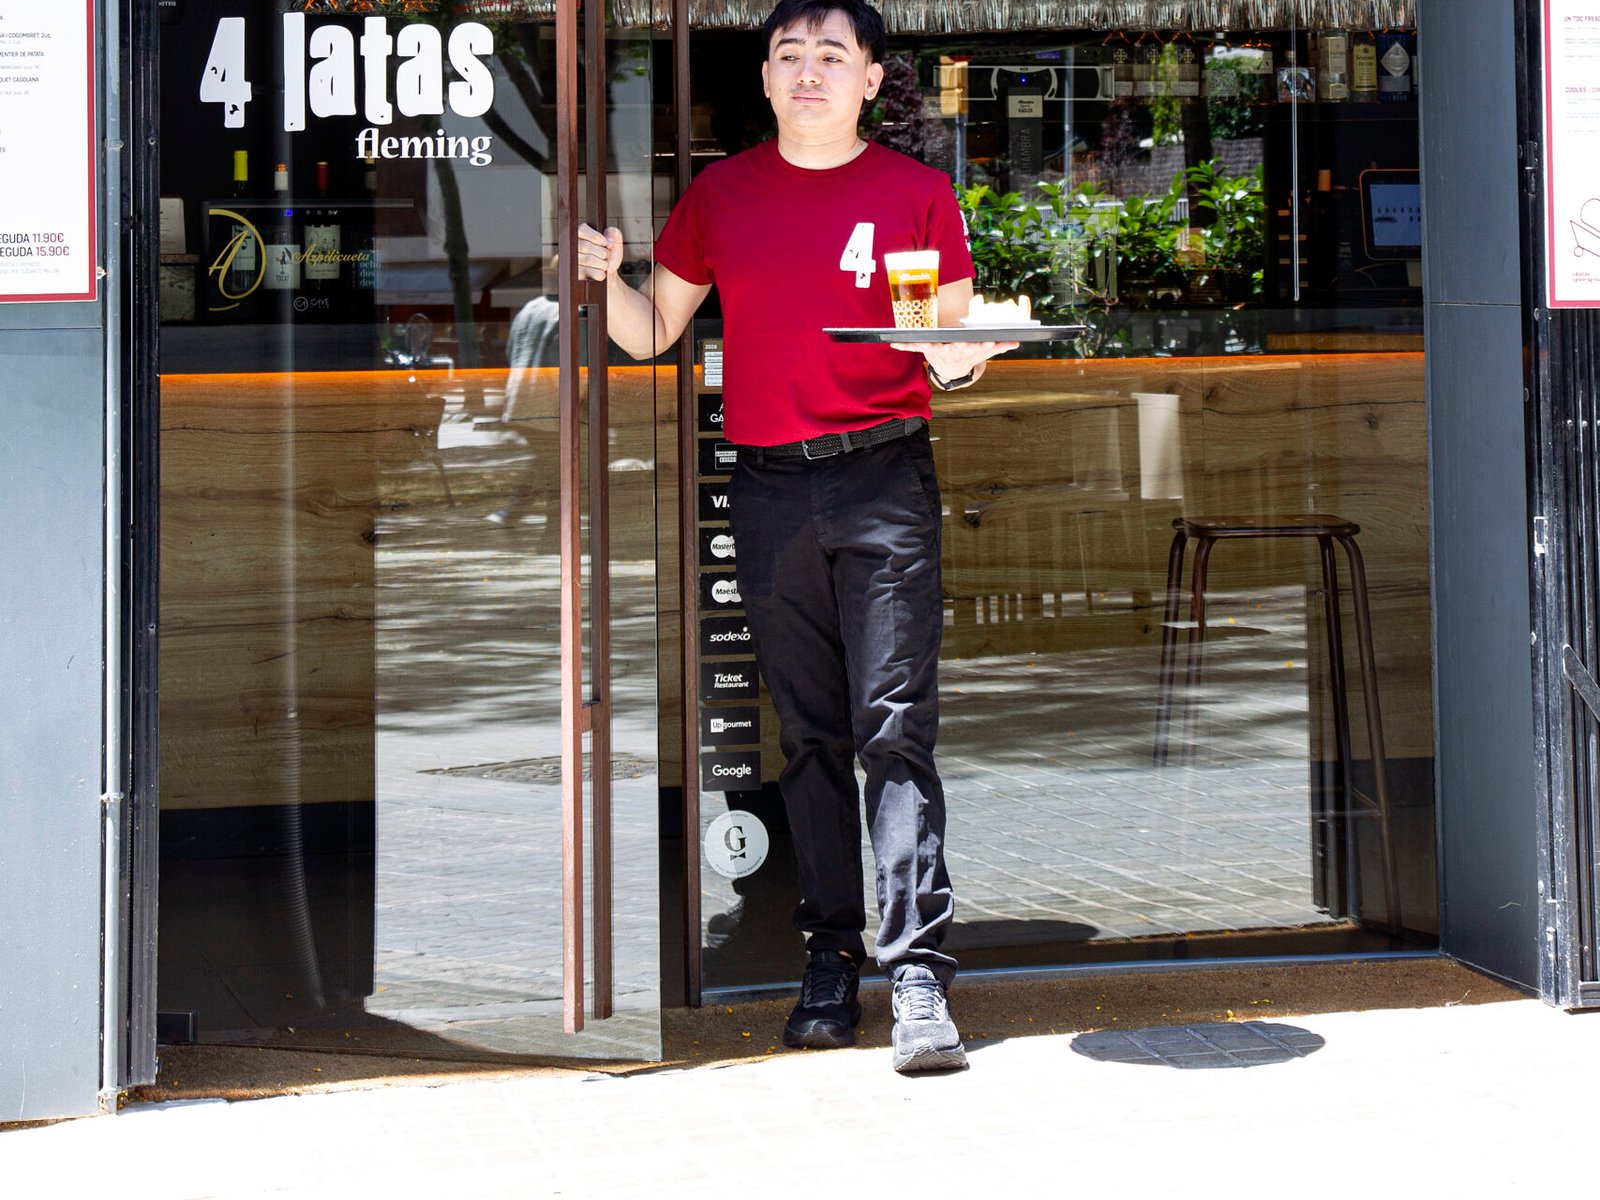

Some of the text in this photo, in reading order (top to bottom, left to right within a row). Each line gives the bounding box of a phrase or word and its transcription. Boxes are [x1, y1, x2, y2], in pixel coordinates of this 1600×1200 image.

[200, 11, 494, 132] 4 latas
[355, 128, 493, 167] fleming
[32, 232, 64, 243] 11.90€
[35, 246, 70, 257] 15.90€
[839, 222, 877, 289] 4
[710, 495, 730, 508] VI
[709, 629, 751, 642] sodexo
[714, 673, 743, 683] Ticket
[714, 681, 749, 689] Restaurant
[712, 763, 752, 778] Google
[724, 825, 747, 852] G
